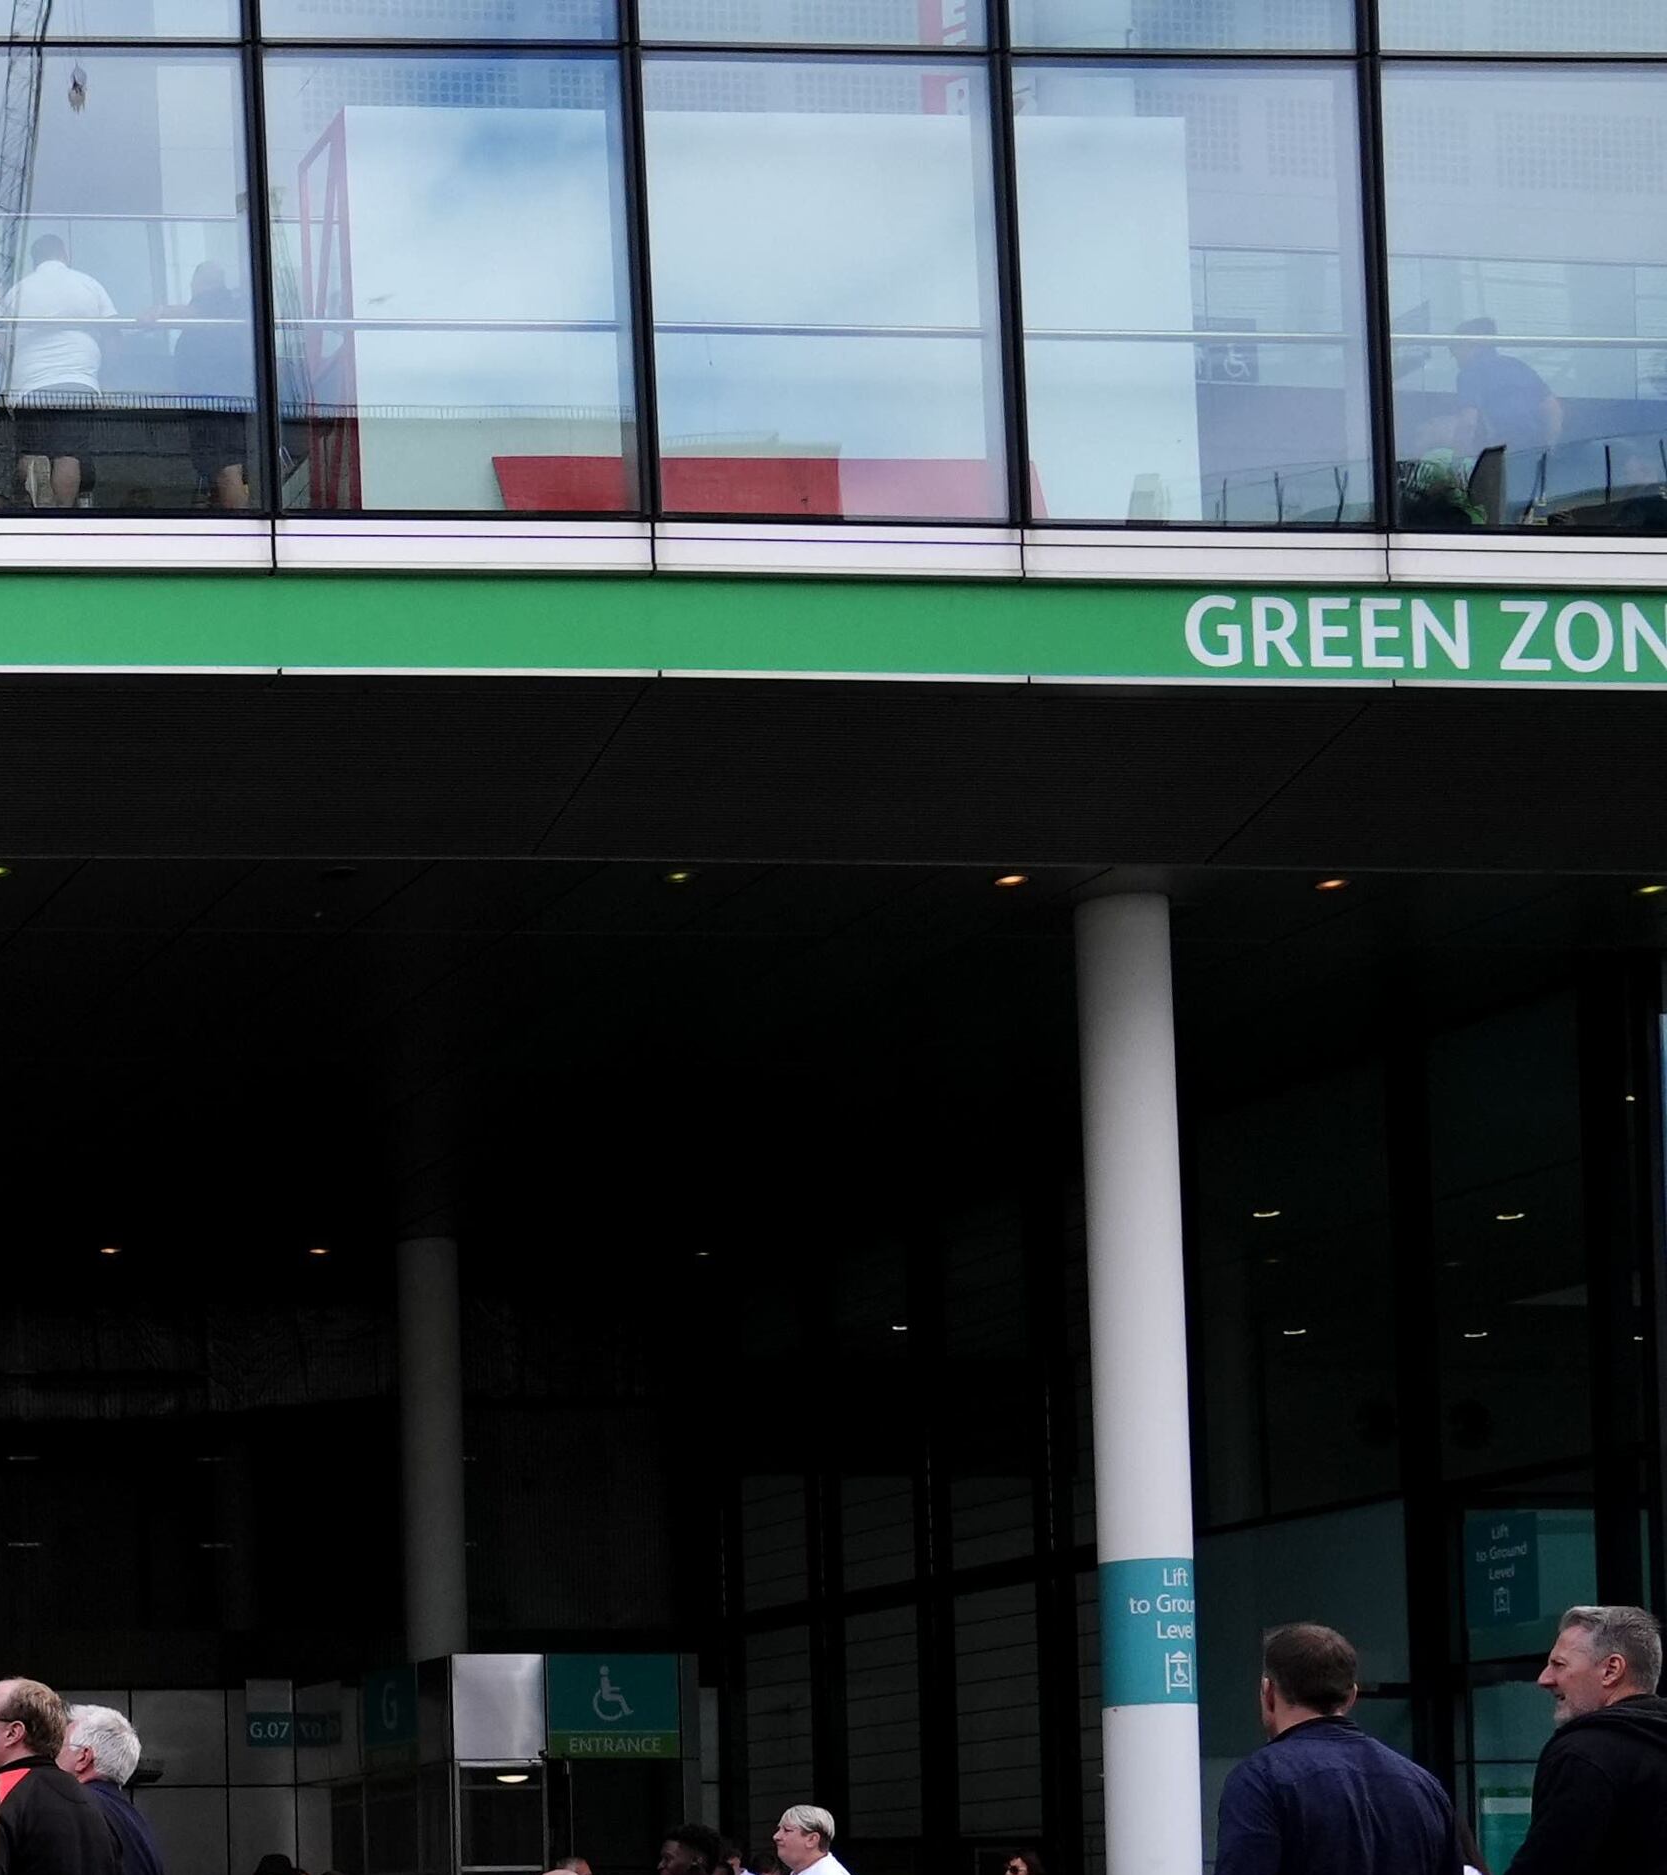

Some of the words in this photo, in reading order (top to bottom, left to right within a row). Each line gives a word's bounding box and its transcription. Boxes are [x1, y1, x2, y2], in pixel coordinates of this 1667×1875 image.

[1184, 595, 1470, 669] GREEN
[1490, 1543, 1527, 1561] Ground
[1162, 1568, 1188, 1588] Lift
[1489, 1564, 1515, 1581] Level
[1130, 1598, 1150, 1614] to
[249, 1720, 290, 1740] G.07
[569, 1737, 662, 1754] ENTRANCE
